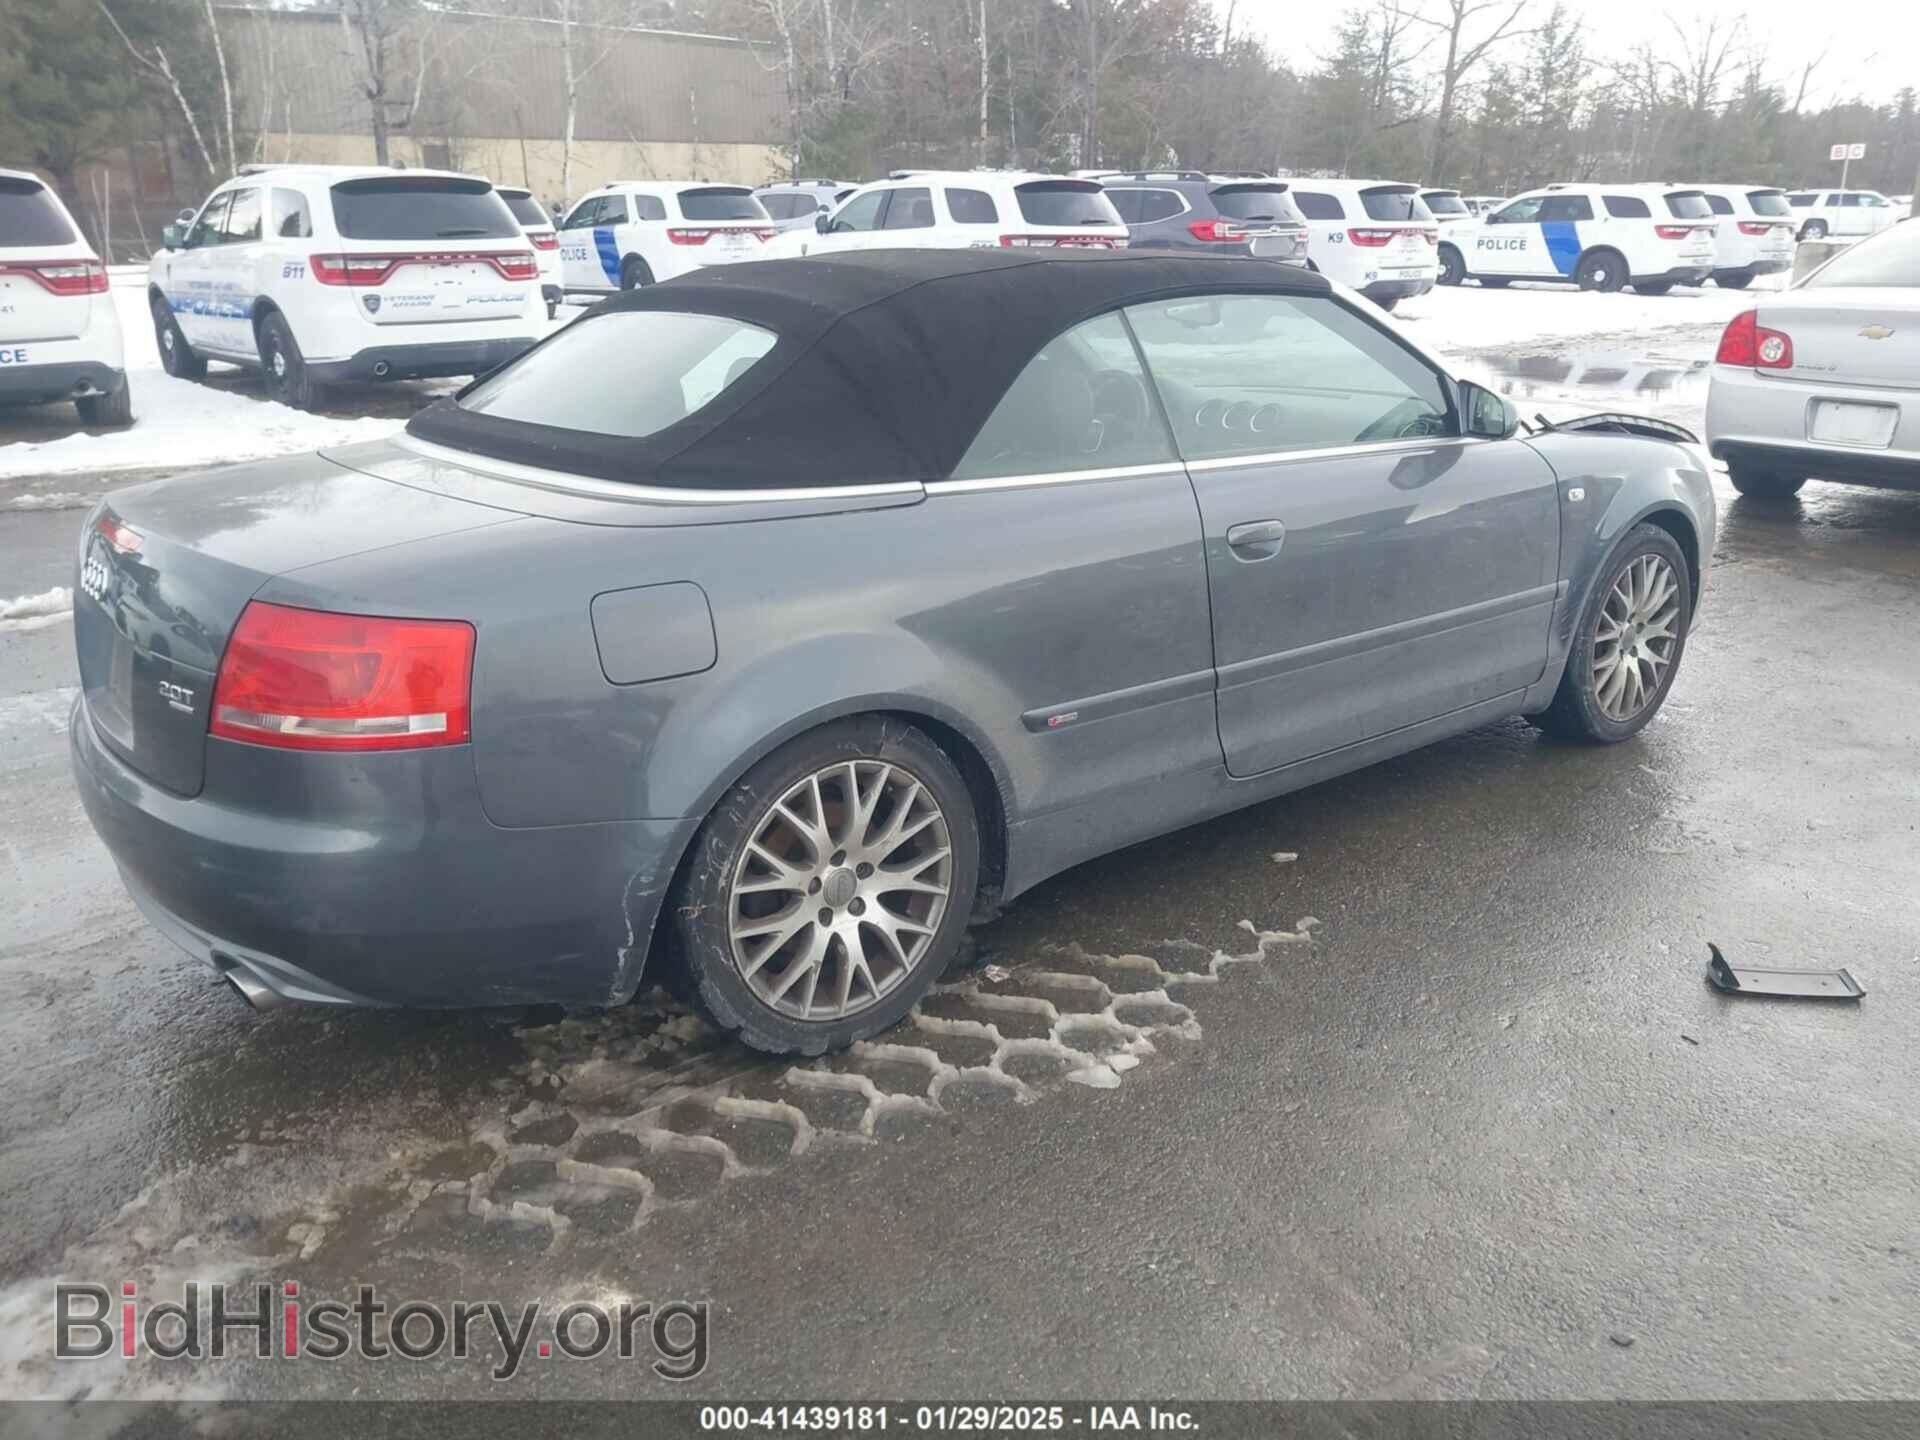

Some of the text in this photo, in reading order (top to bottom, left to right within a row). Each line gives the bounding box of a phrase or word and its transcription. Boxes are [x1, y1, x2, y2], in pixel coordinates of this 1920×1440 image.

[1328, 232, 1343, 243] K9
[1477, 239, 1527, 250] POLICE
[560, 248, 587, 261] OLICE
[282, 266, 304, 279] 911
